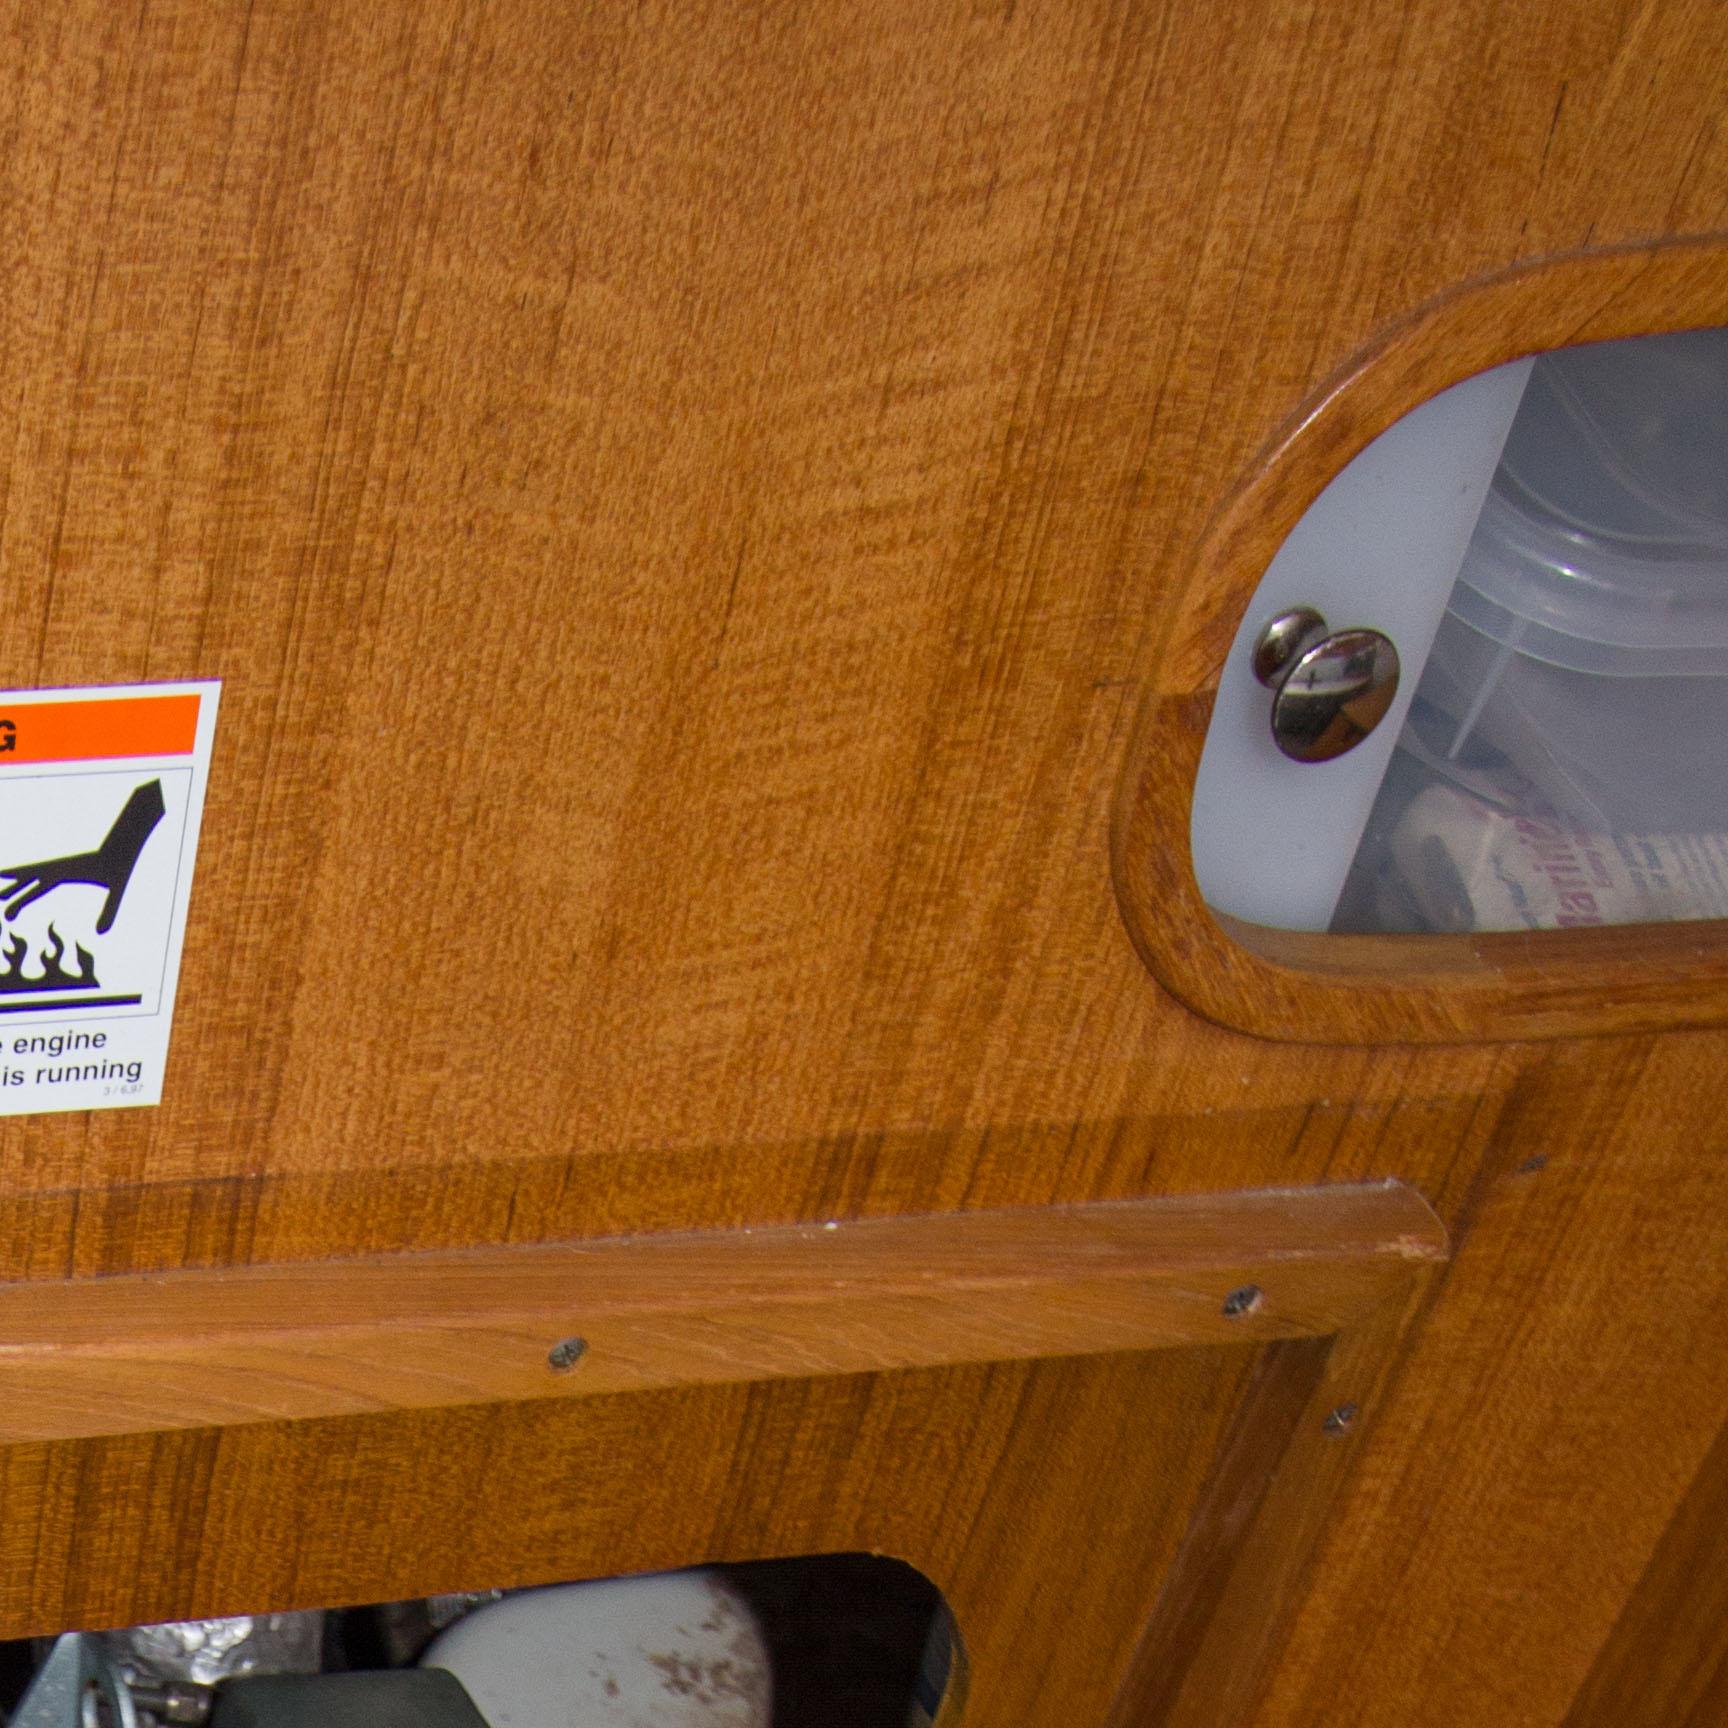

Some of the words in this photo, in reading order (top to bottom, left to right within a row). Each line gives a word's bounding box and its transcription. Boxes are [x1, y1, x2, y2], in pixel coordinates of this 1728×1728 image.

[13, 1030, 107, 1056] engine
[3, 1066, 24, 1086] is
[36, 1059, 142, 1083] running
